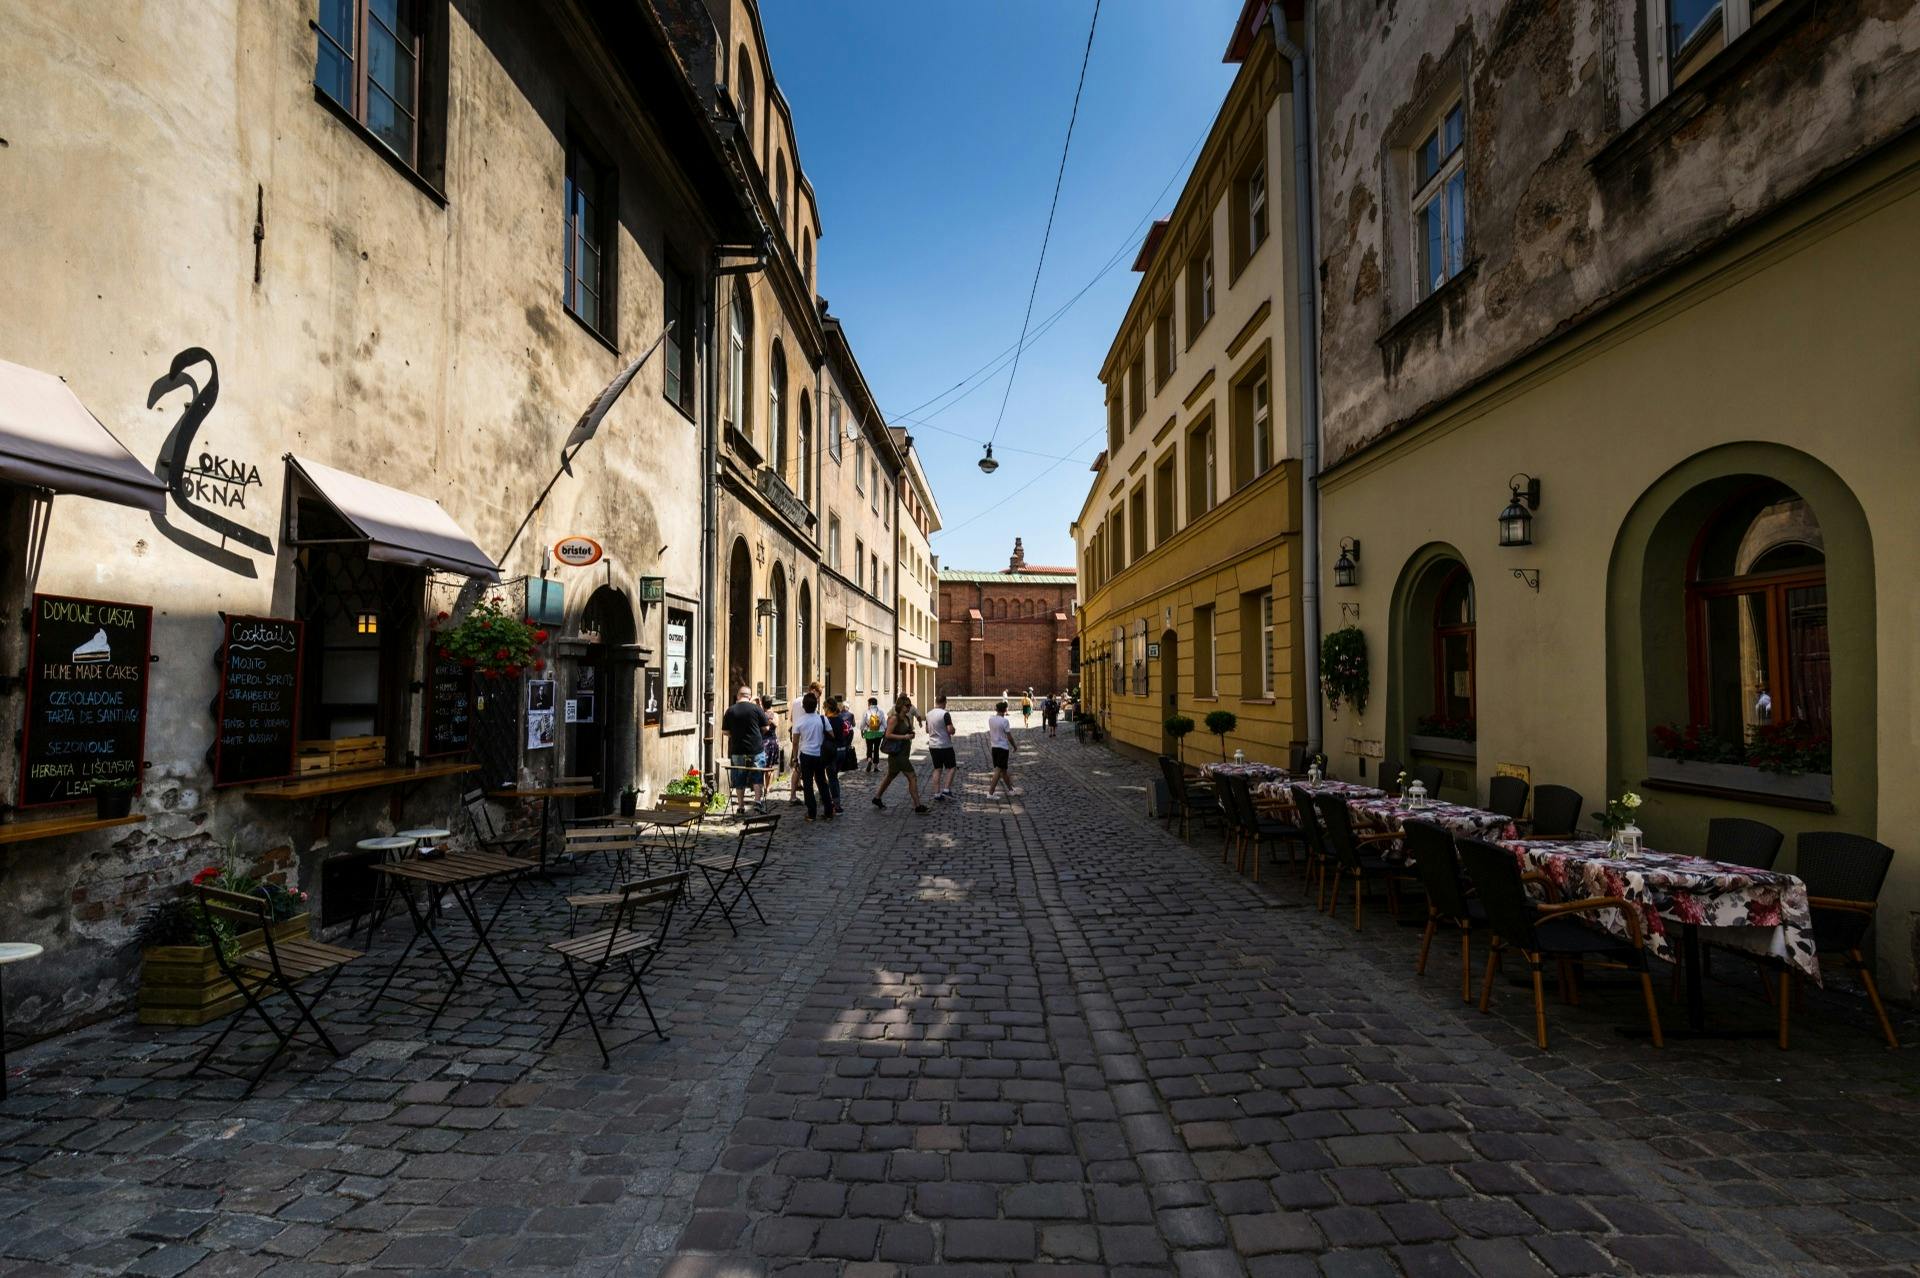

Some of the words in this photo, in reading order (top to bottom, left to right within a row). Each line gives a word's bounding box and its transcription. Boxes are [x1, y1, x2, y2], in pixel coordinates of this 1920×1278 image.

[199, 453, 263, 487] OKNA
[43, 601, 94, 624] DOMOWE
[98, 606, 135, 629] CIASTA
[232, 623, 295, 645] Cocktails
[231, 656, 267, 670] MOJITO
[43, 664, 72, 680] HOME
[75, 665, 102, 679] MADE
[106, 665, 139, 681] CAKES
[230, 674, 263, 685] APEROL
[49, 691, 124, 706] CZEKOLADOWE
[252, 702, 281, 713] FIELDS
[47, 708, 75, 724] TARTA
[80, 710, 93, 724] DE
[48, 739, 115, 754] SEZONOWE
[31, 763, 75, 778] HERBATA
